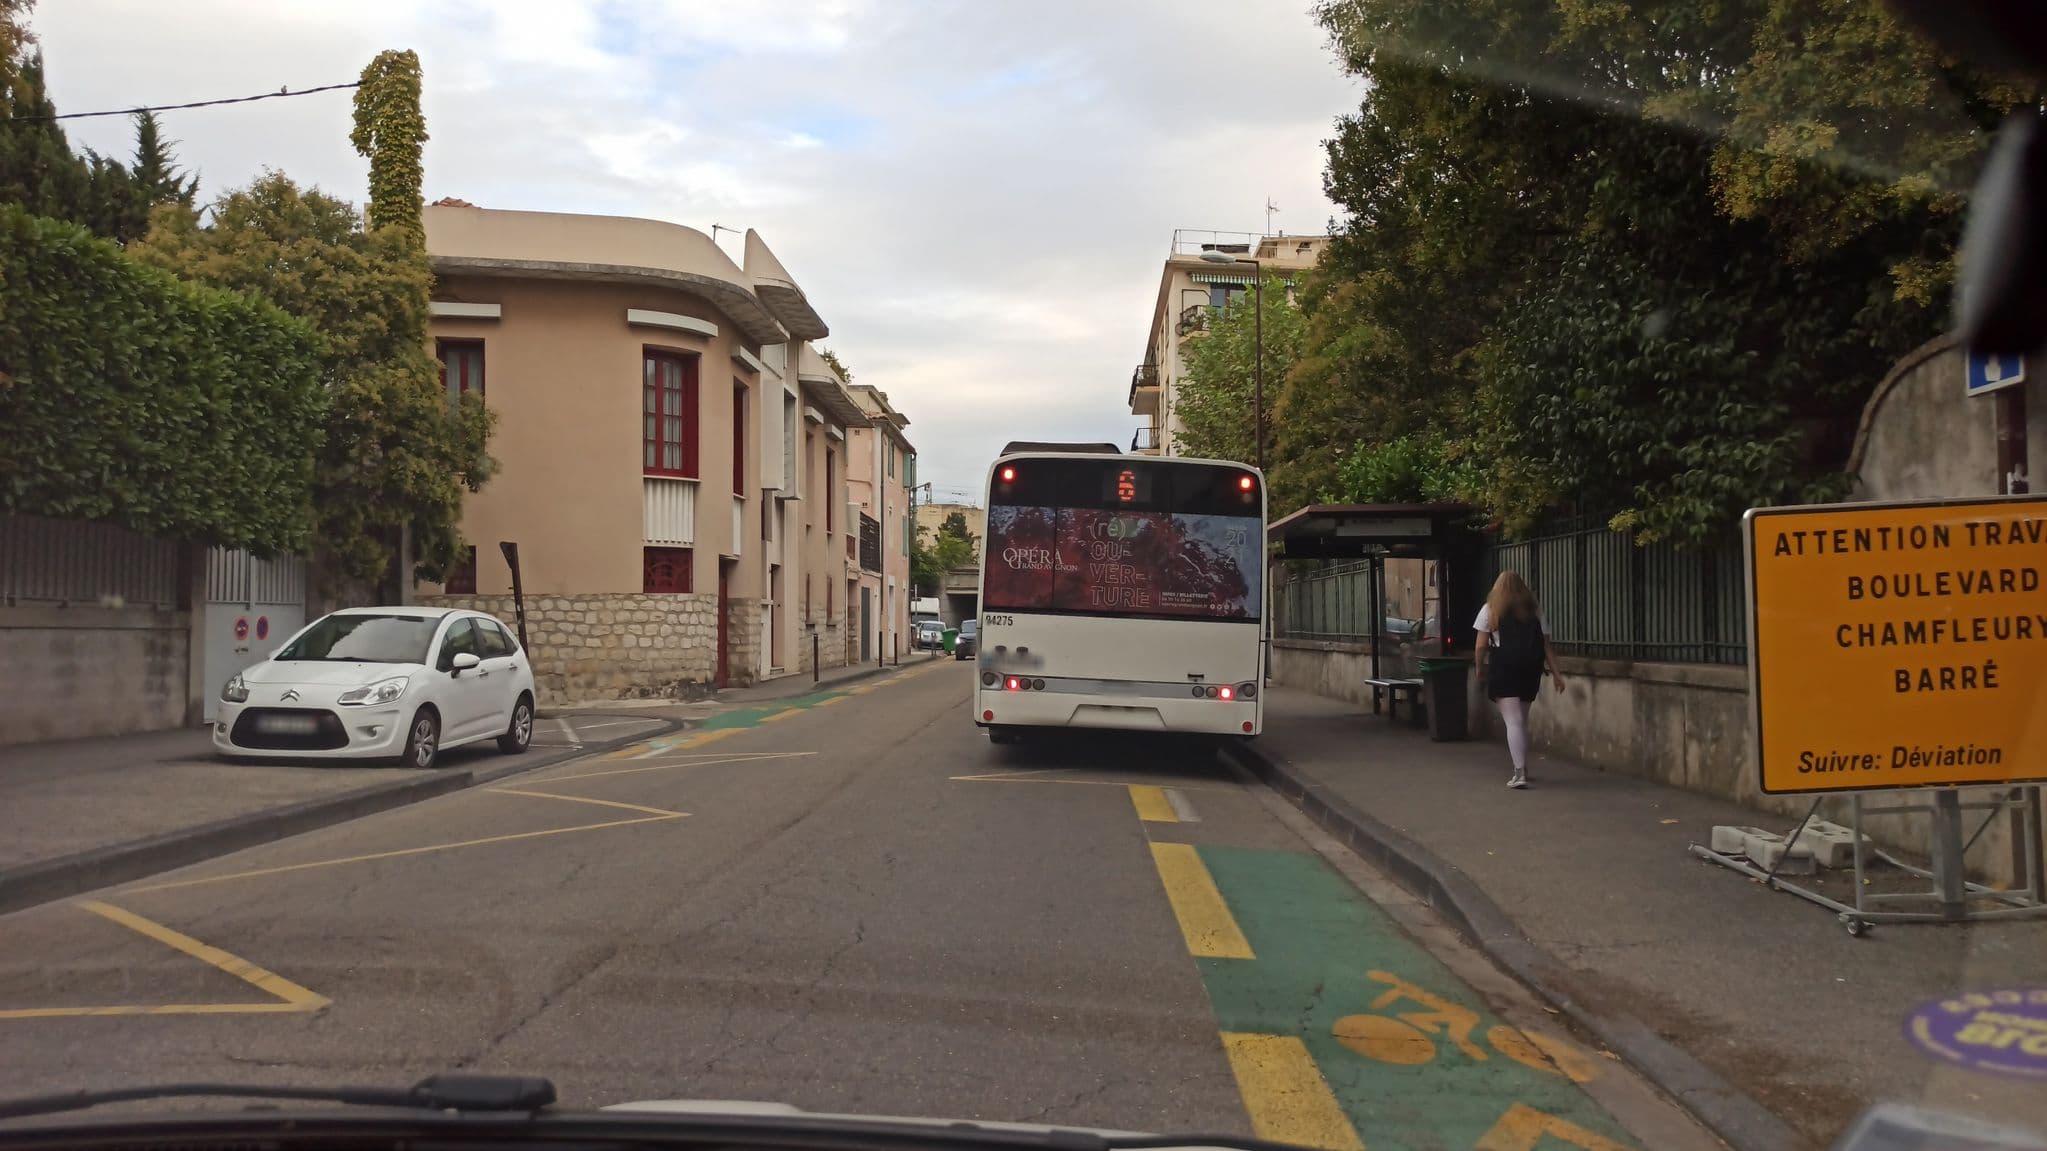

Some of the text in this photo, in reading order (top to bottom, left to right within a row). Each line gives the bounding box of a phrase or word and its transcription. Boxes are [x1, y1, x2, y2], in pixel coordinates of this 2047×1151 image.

[1118, 470, 1135, 501] 6
[1774, 518, 2047, 557] ATTENTION TRAV
[1090, 585, 1151, 608] TURE
[1848, 567, 2039, 600] BOULEVARD
[985, 615, 1014, 626] 94275
[1836, 614, 2047, 648] CHAMFLEURY
[1895, 659, 2000, 693] BARRÉ
[1798, 744, 2002, 774] Suivre: Déviation
